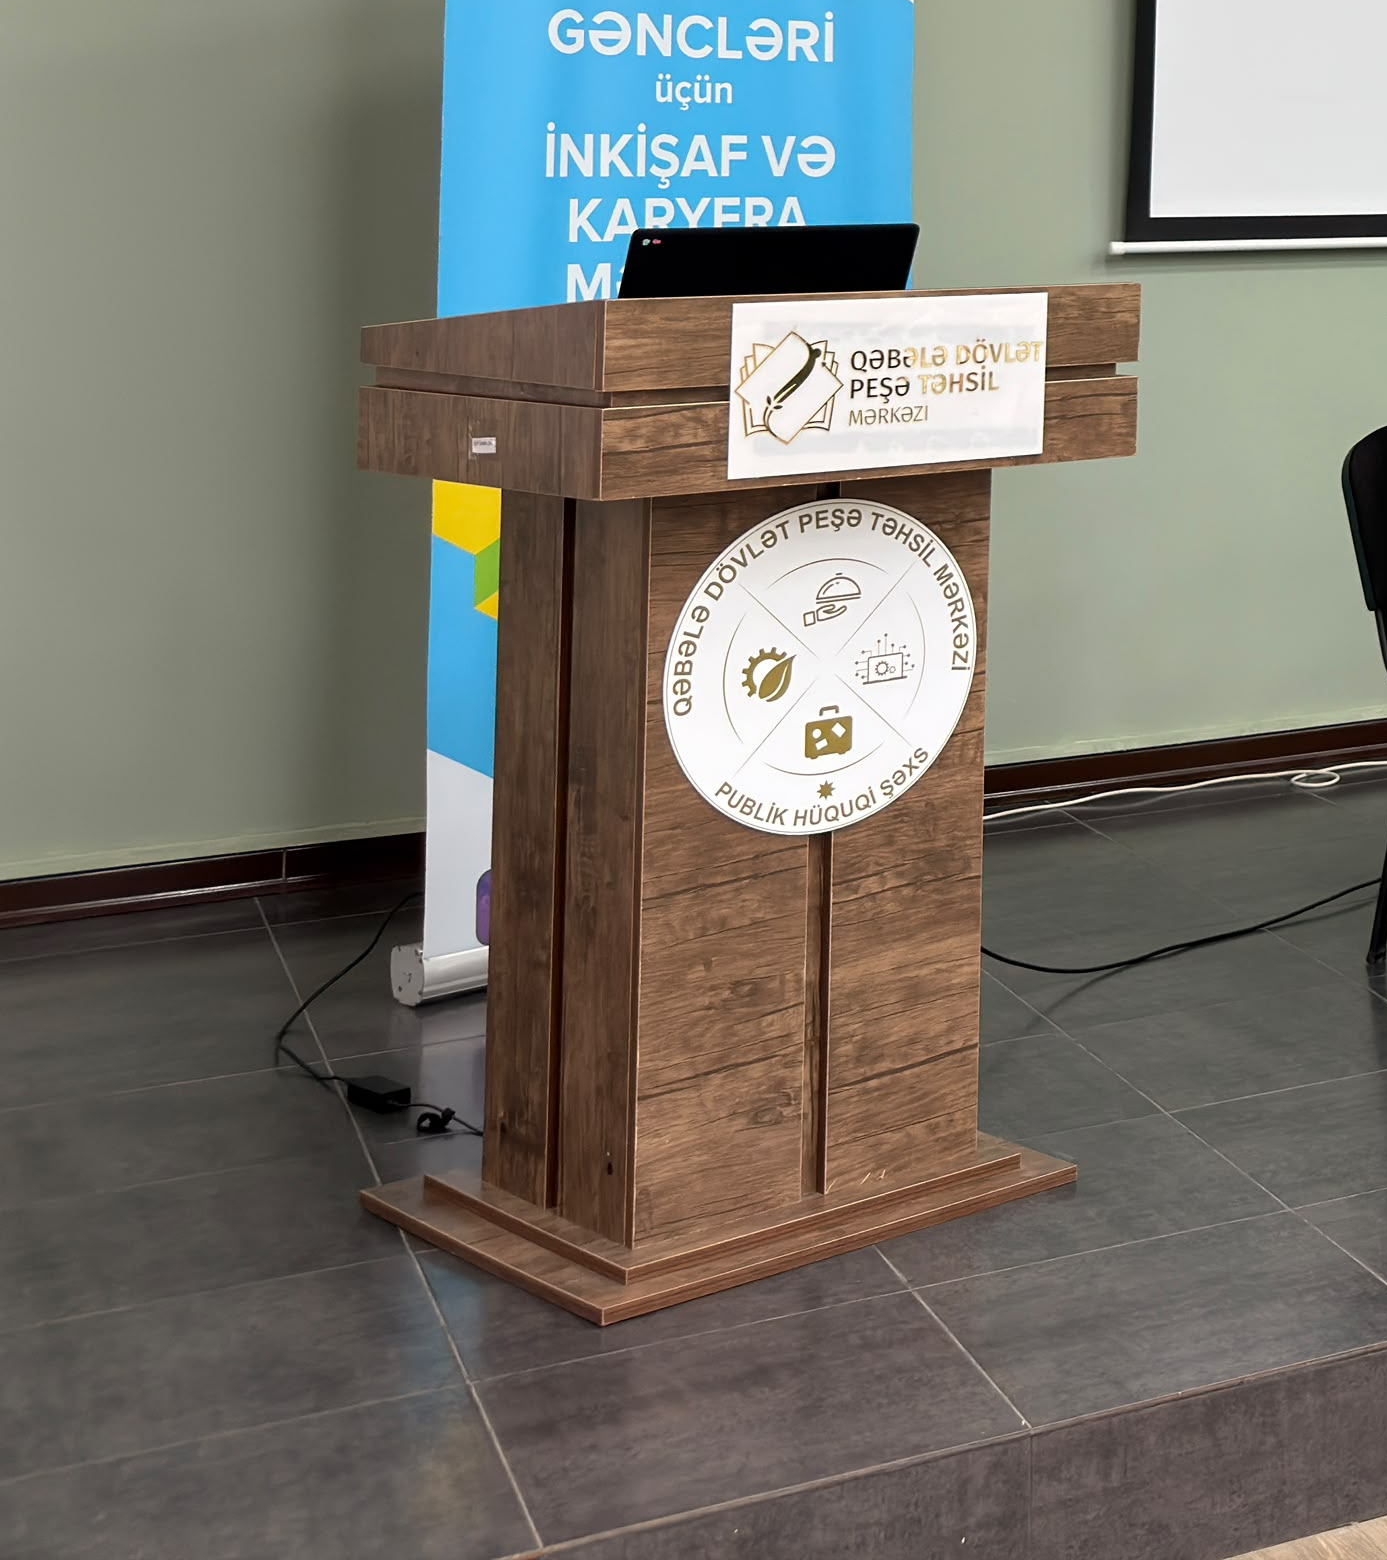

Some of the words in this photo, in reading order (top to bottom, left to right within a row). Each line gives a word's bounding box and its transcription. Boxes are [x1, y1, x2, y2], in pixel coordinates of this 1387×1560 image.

[547, 8, 834, 63] GƏNCLƏRİ
[655, 72, 733, 111] üçün
[545, 121, 748, 189] İNKİŞAF
[761, 134, 836, 178] VƏ
[850, 345, 948, 373] QƏBƏLƏ
[955, 338, 1043, 366] DÖVLƏT
[850, 376, 911, 404] PEŞƏ
[917, 365, 1000, 395] TƏHSİL
[672, 605, 711, 717] QƏBƏLƏ
[703, 520, 790, 602] DÖVLƏT
[798, 508, 863, 534] PEŞƏ
[870, 511, 936, 568] TƏHSİL
[933, 563, 971, 671] MƏRKƏZİ
[714, 781, 789, 826] PUBLİK
[793, 785, 877, 827] HÜQUQİ
[879, 747, 929, 800] ŞƏXS
